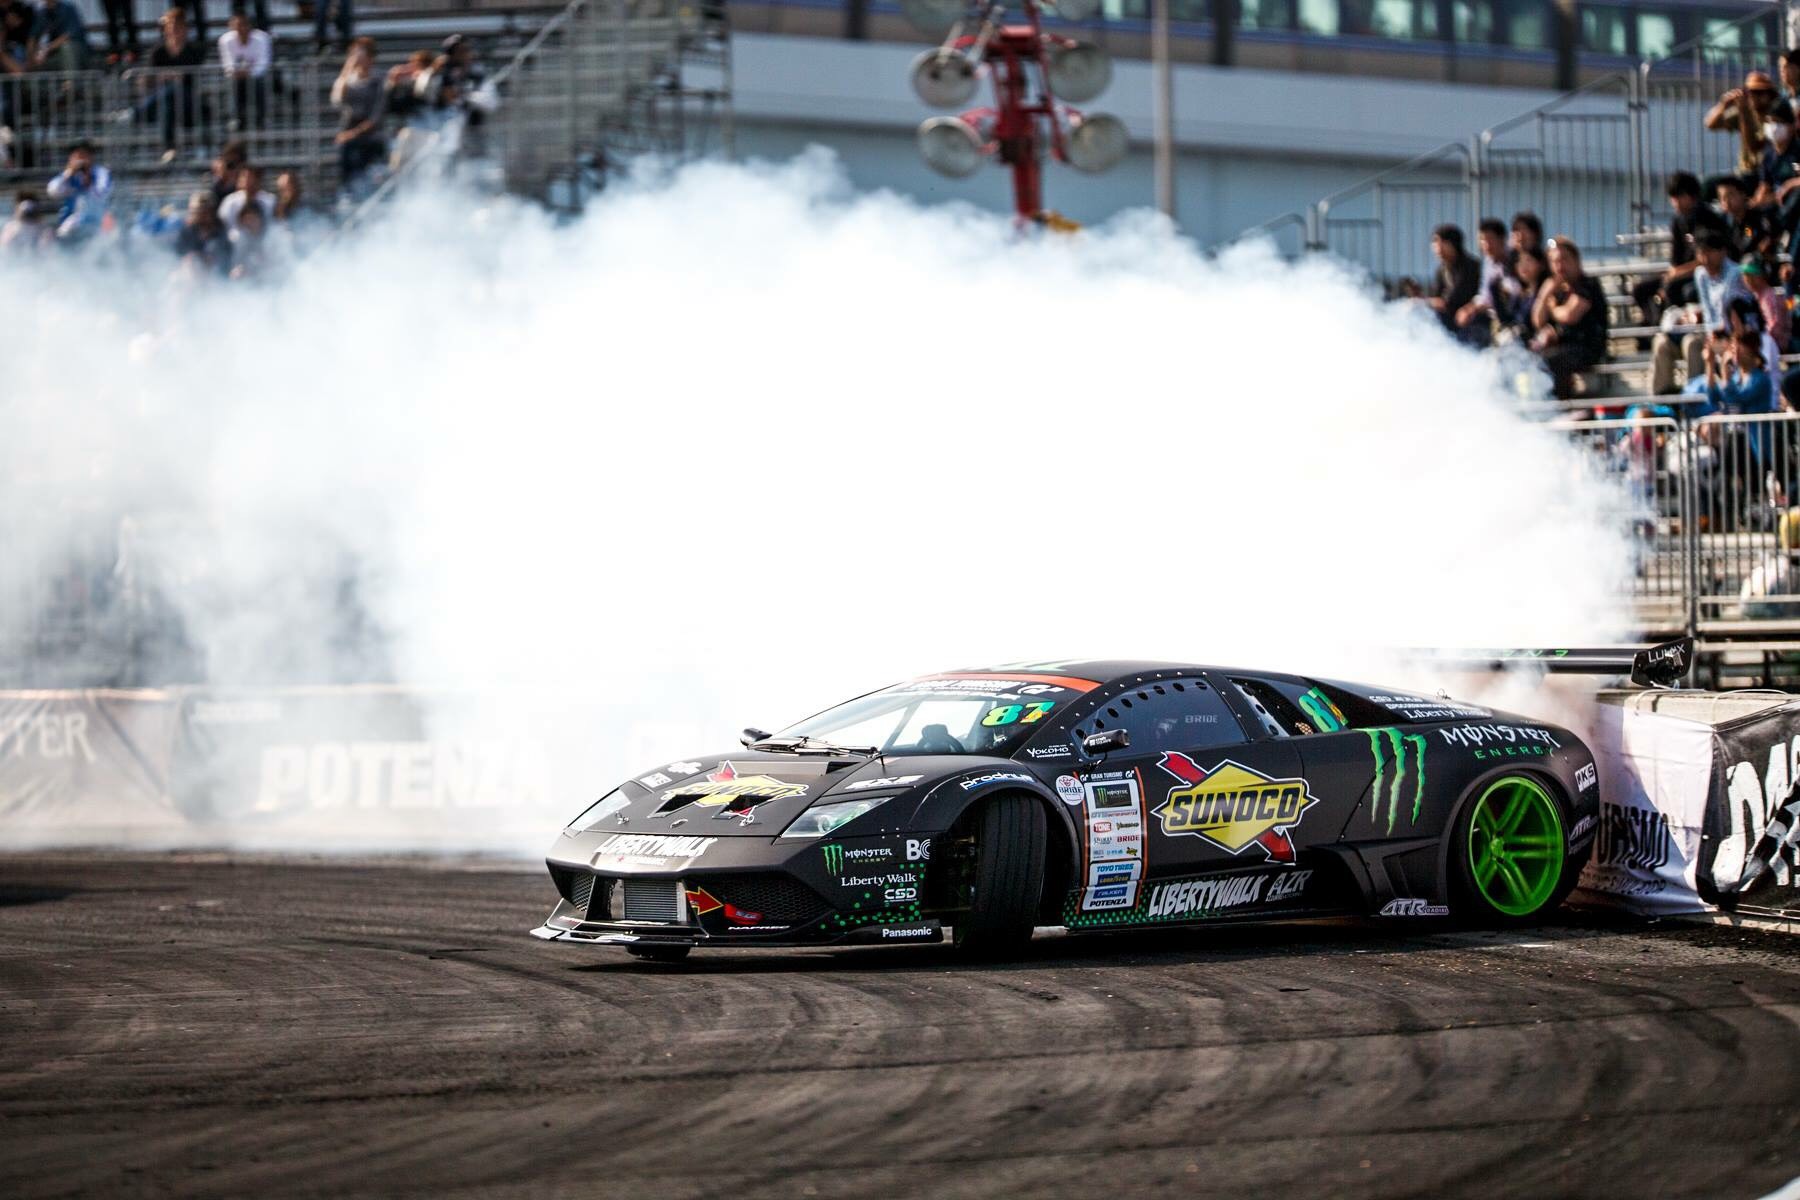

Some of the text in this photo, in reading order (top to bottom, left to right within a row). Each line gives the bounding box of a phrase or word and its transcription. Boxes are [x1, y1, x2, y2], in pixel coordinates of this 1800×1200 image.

[981, 701, 1056, 727] 87
[1298, 686, 1349, 733] 87
[1185, 714, 1218, 723] BRIDE
[1440, 724, 1560, 748] MONSTER
[1026, 746, 1069, 758] YOKOMO
[1474, 747, 1555, 760] ENERGY
[1058, 786, 1083, 794] BRIDE
[1169, 787, 1300, 826] SUNOCO
[1117, 834, 1140, 842] BRIDE
[845, 848, 892, 858] MONSTER
[841, 873, 916, 886] Liberty Walk
[884, 887, 917, 899] CSD
[1089, 898, 1127, 907] POTENZA
[882, 926, 932, 938] Panasonic
